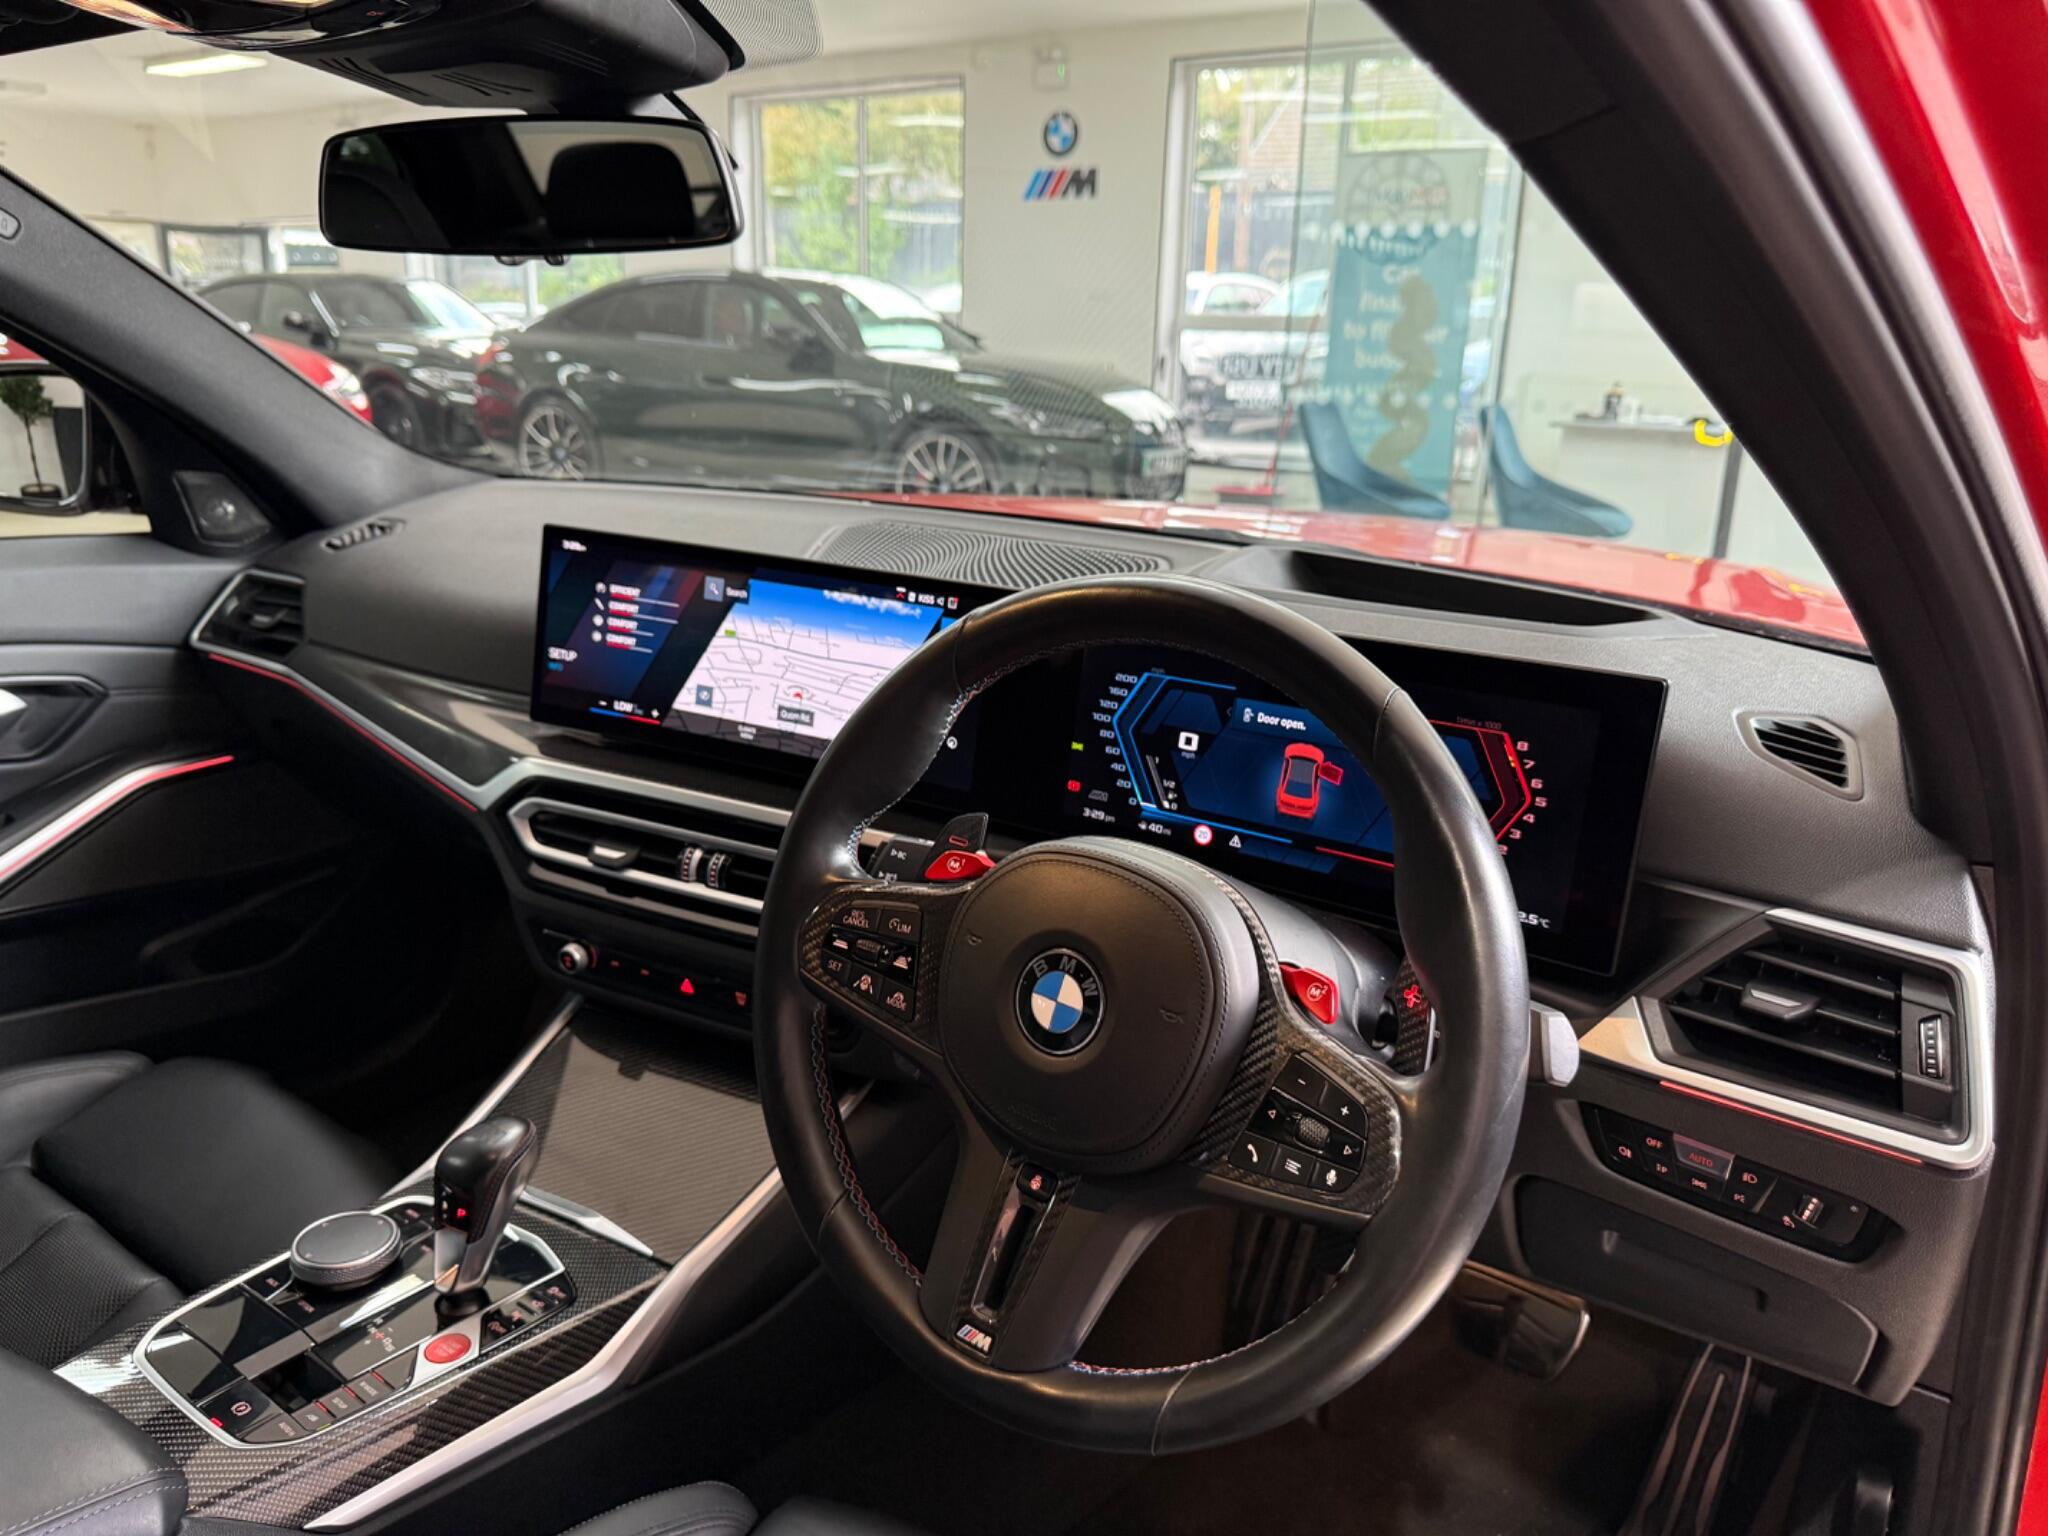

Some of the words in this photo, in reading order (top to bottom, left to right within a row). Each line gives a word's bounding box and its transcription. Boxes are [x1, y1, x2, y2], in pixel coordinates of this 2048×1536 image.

[548, 647, 578, 662] SETUP
[1115, 673, 1138, 684] 200
[1108, 686, 1128, 697] 160
[1099, 699, 1118, 709] 120
[1092, 712, 1111, 723] 100
[1257, 711, 1280, 726] Door
[1280, 718, 1307, 731] open.
[1099, 729, 1115, 739] 80
[1178, 731, 1199, 751] 0
[1517, 741, 1528, 752] 8
[1105, 746, 1120, 755] 60
[1110, 763, 1126, 772] 40
[1523, 759, 1536, 769] 7
[1116, 779, 1132, 789] 20
[1530, 778, 1543, 789] 6
[1534, 796, 1547, 807] 5
[1522, 813, 1535, 823] 4
[1509, 828, 1521, 840] 3
[843, 915, 868, 929] CANCEL
[897, 923, 911, 934] LIM
[827, 960, 842, 972] SET
[1033, 956, 1099, 997] BMW
[1646, 1137, 1663, 1149] OFF
[1689, 1152, 1714, 1168] AUTO
